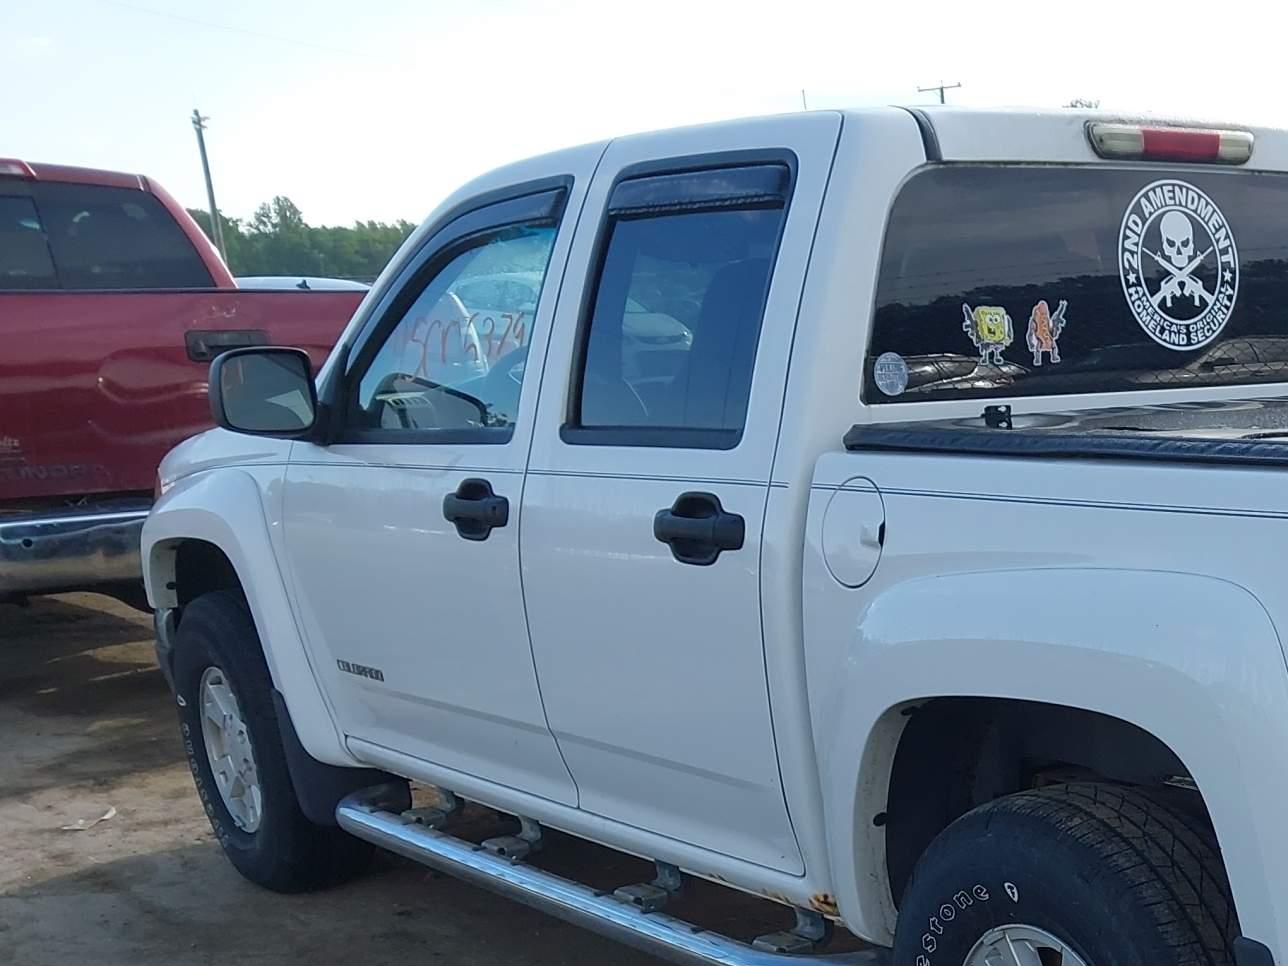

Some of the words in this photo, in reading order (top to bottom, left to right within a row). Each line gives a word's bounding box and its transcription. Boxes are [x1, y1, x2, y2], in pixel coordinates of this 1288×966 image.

[1123, 214, 1143, 269] 2ND
[1140, 186, 1235, 267] AMENDMENT
[1127, 284, 1188, 345] HOMELAND
[1190, 287, 1235, 344] SECURITY
[1136, 286, 1187, 333] AMERICA'S
[1189, 286, 1229, 333] ORIGINAL
